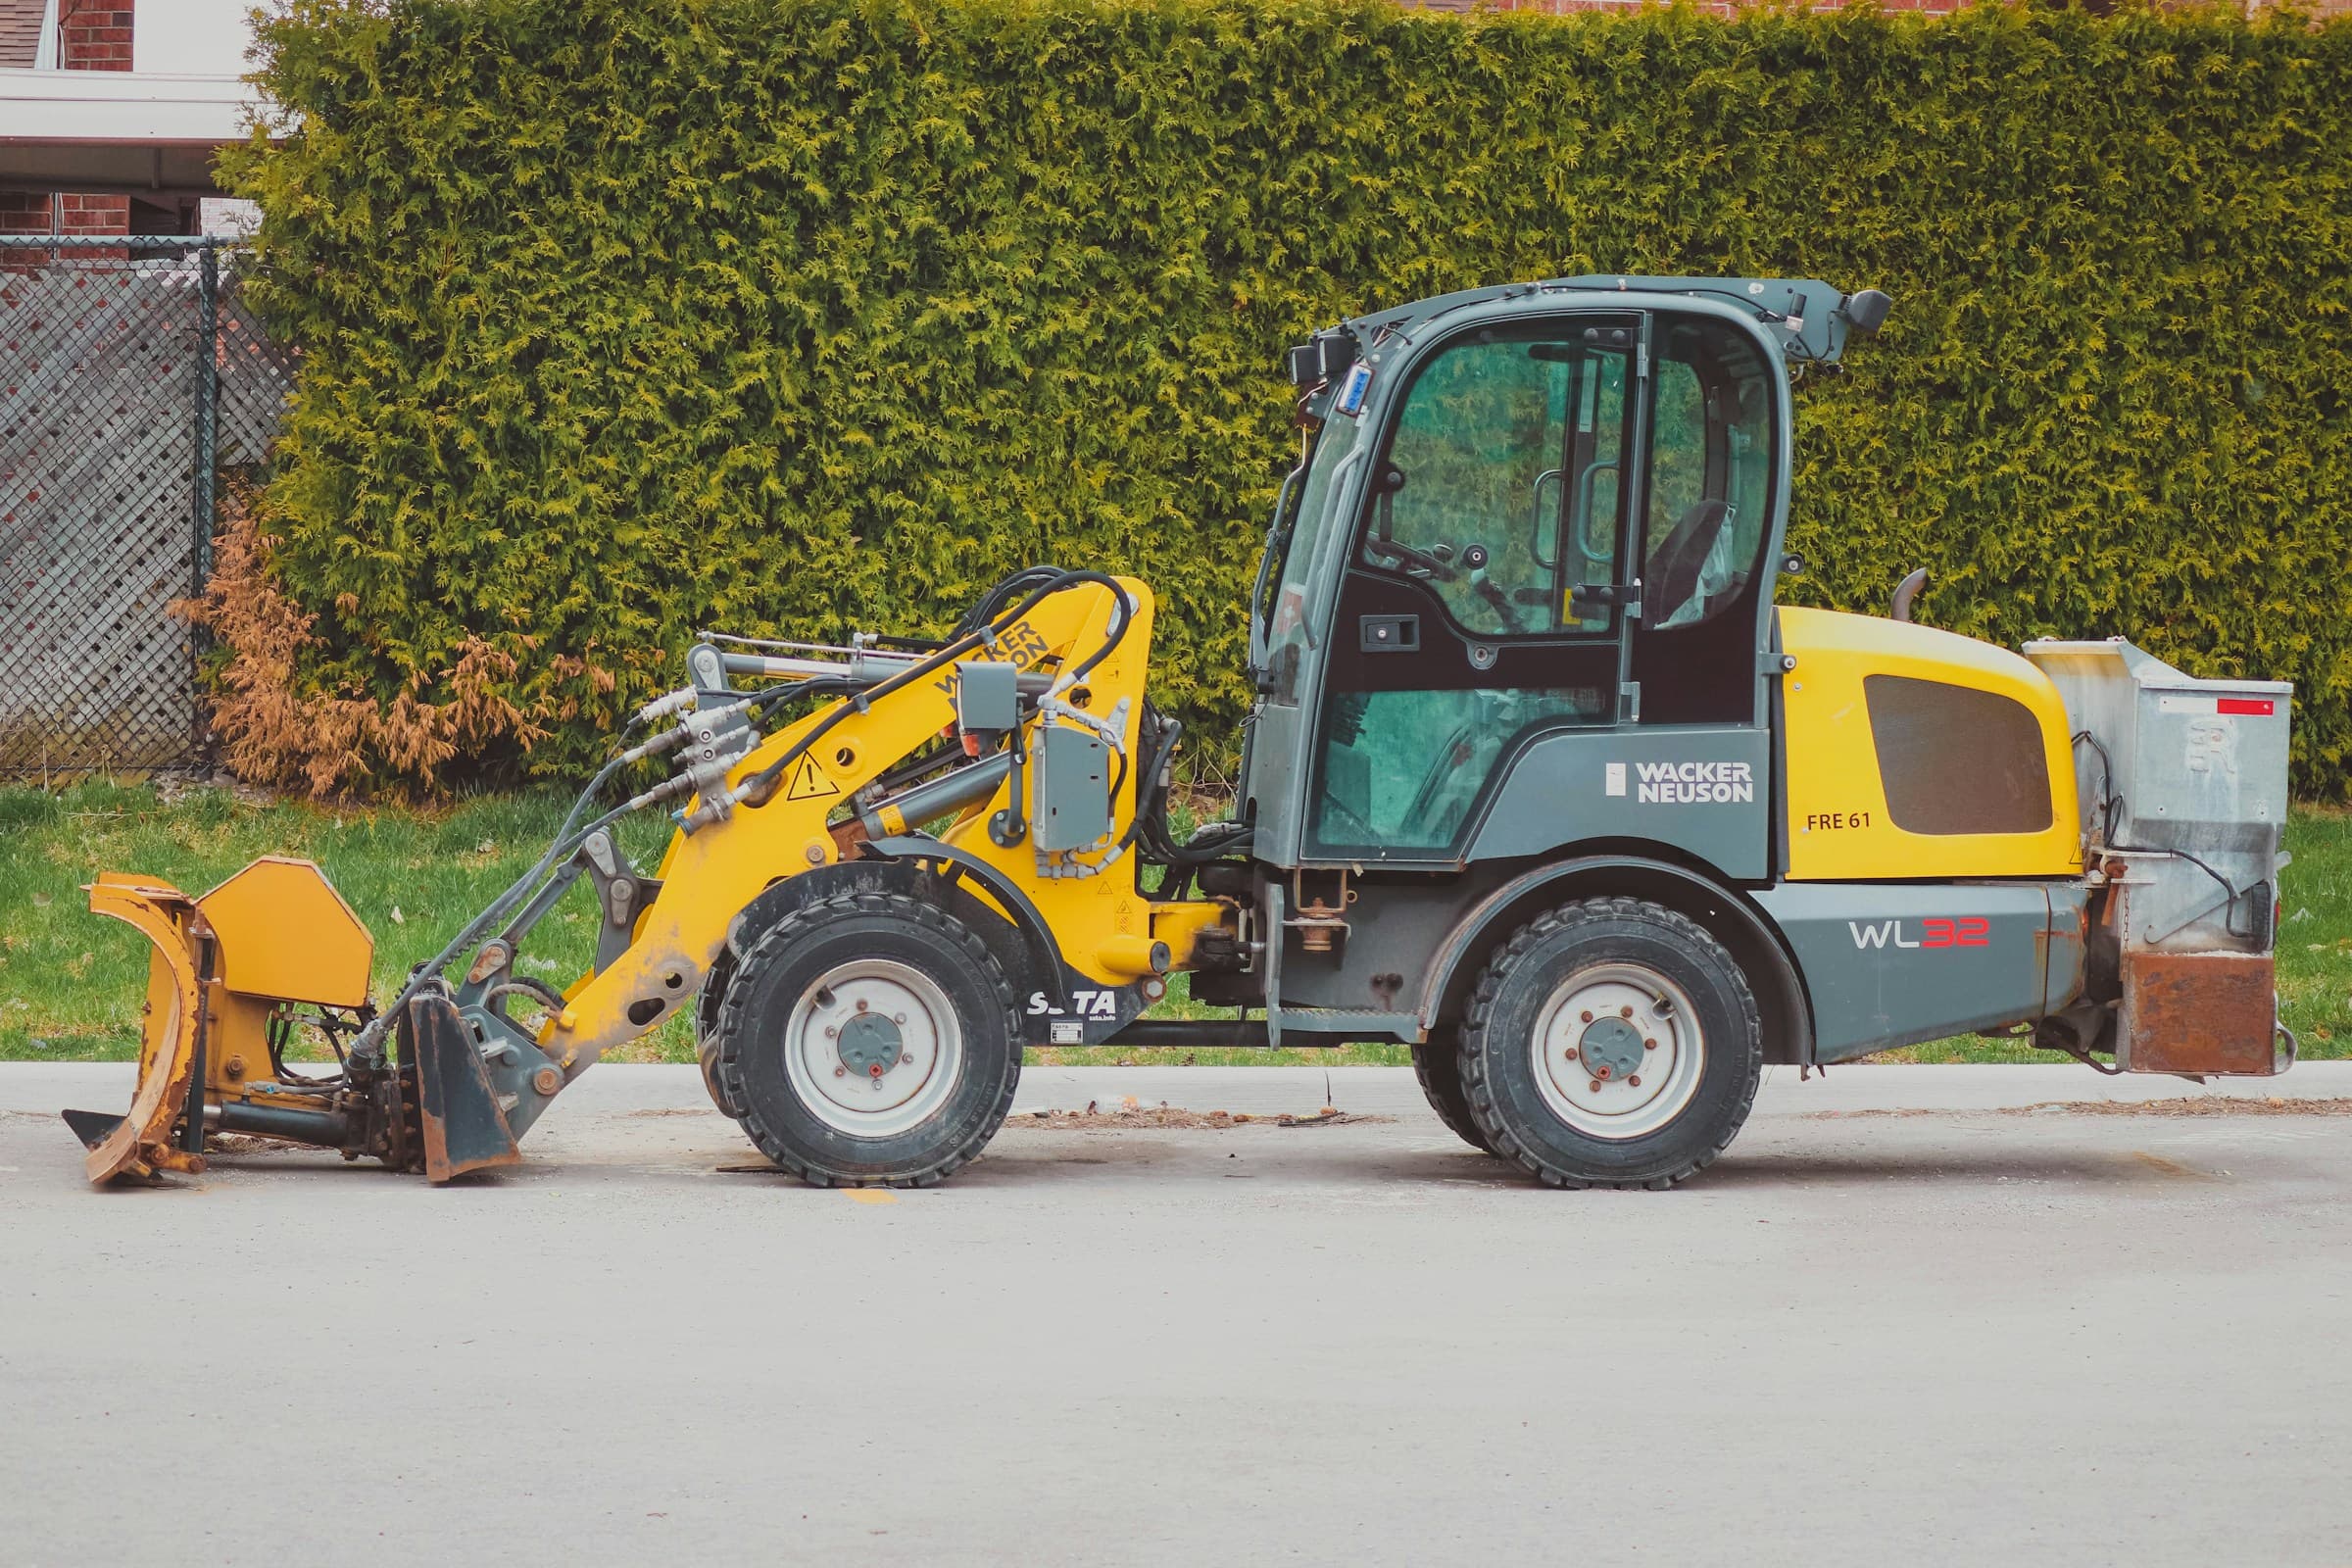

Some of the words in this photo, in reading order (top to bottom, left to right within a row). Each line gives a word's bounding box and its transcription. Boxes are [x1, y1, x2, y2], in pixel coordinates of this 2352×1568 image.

[1635, 762, 1753, 782] WACKER
[1639, 783, 1753, 803] NEUSON
[1807, 813, 1843, 830] FRE
[1849, 812, 1870, 828] 61
[1848, 917, 1990, 950] WL32
